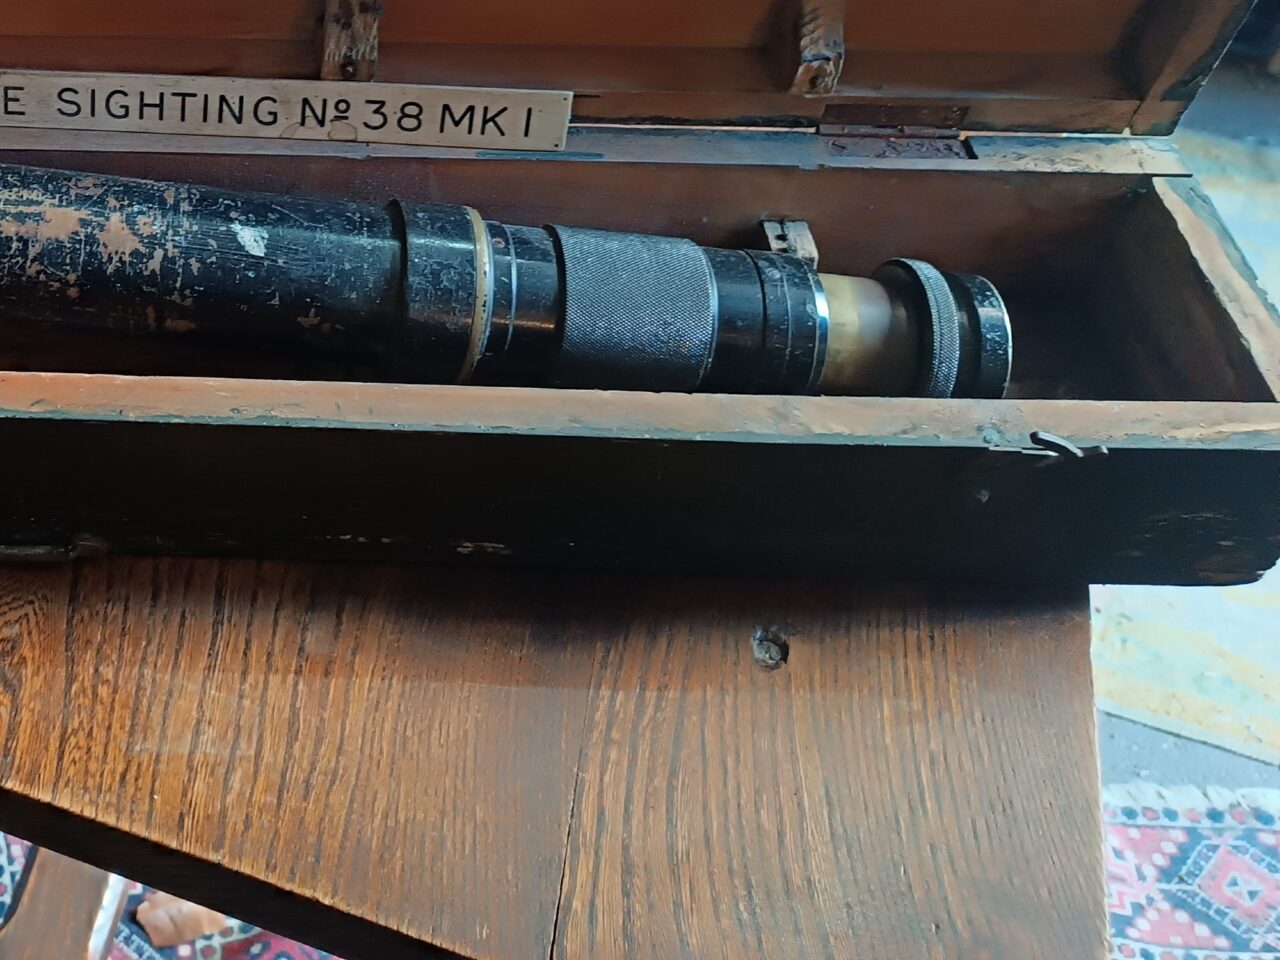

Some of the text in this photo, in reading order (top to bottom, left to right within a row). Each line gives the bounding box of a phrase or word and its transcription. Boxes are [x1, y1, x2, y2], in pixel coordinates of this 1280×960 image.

[56, 87, 278, 126] SIGHTING
[363, 99, 424, 132] 38
[439, 103, 508, 137] MK
